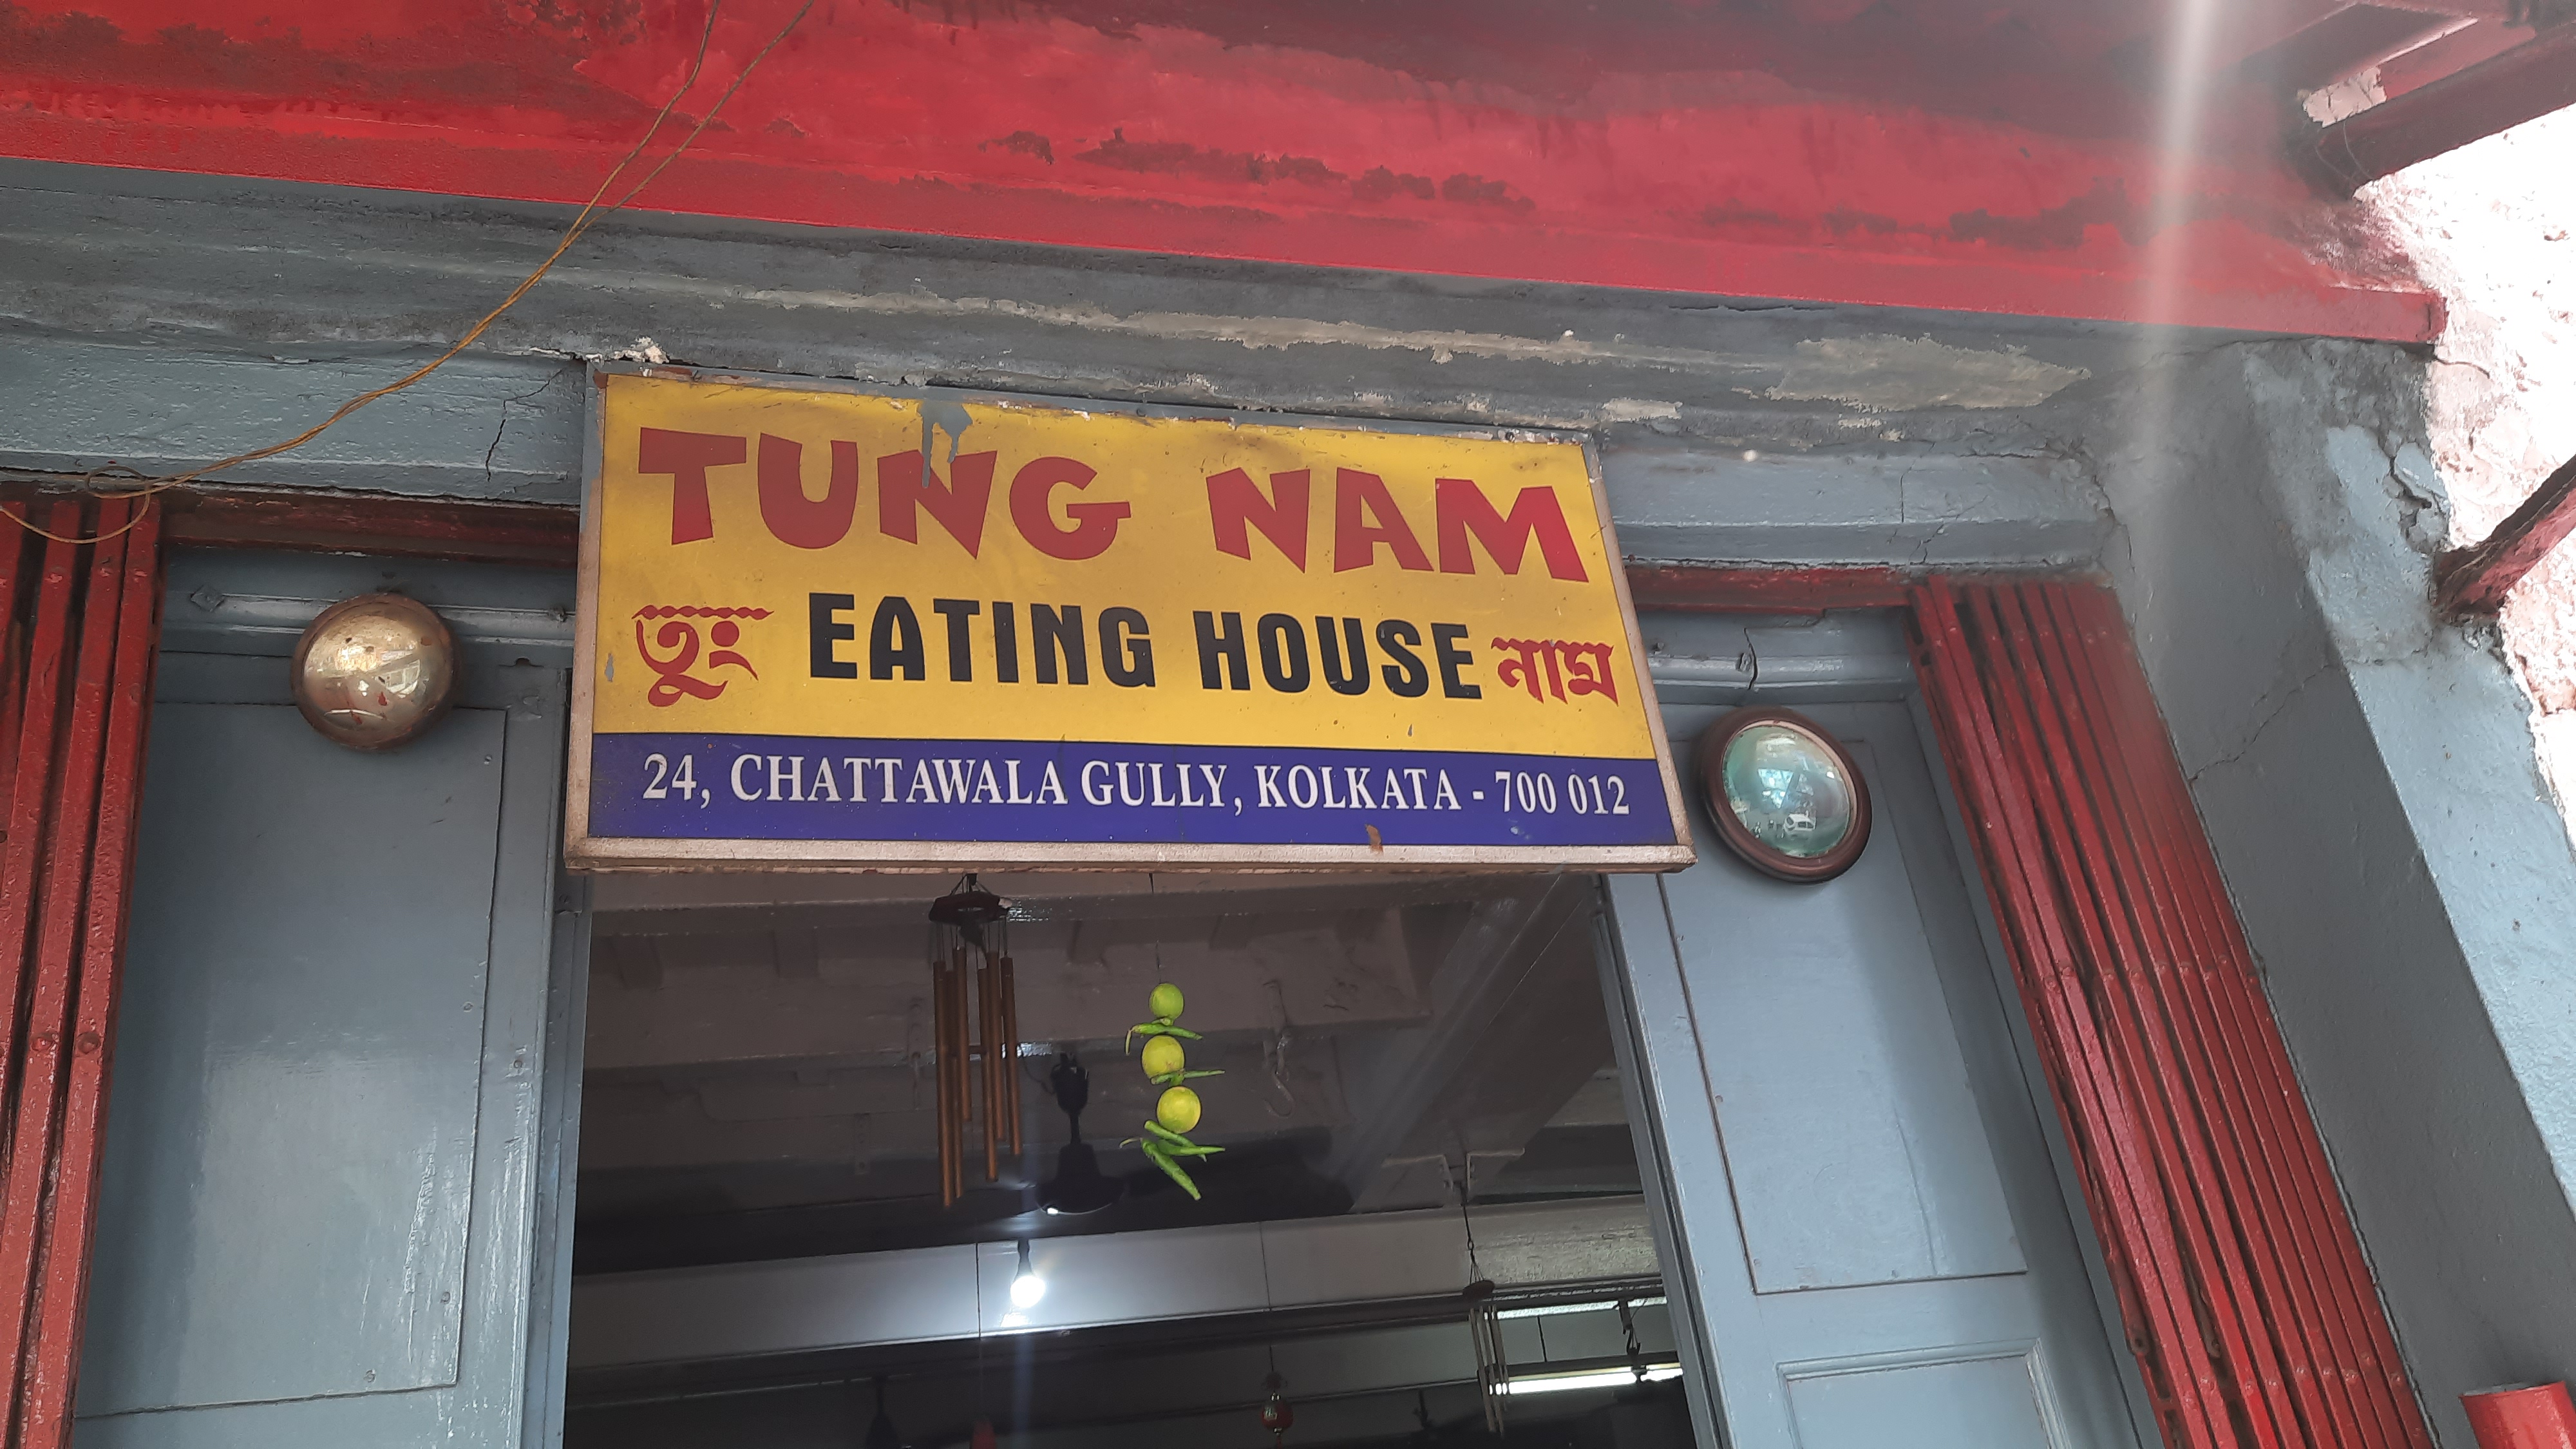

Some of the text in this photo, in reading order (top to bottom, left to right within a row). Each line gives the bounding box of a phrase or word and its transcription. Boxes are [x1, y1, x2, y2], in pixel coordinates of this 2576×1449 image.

[638, 427, 1589, 582] TUNG NAM
[809, 592, 1482, 699] EATING HOUSE
[1491, 637, 1618, 706] নাম
[643, 753, 710, 810] 24,
[731, 754, 1069, 805] CHATTAWALA
[1081, 761, 1242, 816] GULLY,
[1253, 764, 1462, 811] KOLKATA
[1495, 771, 1557, 813] 700
[1567, 774, 1630, 815] 012
